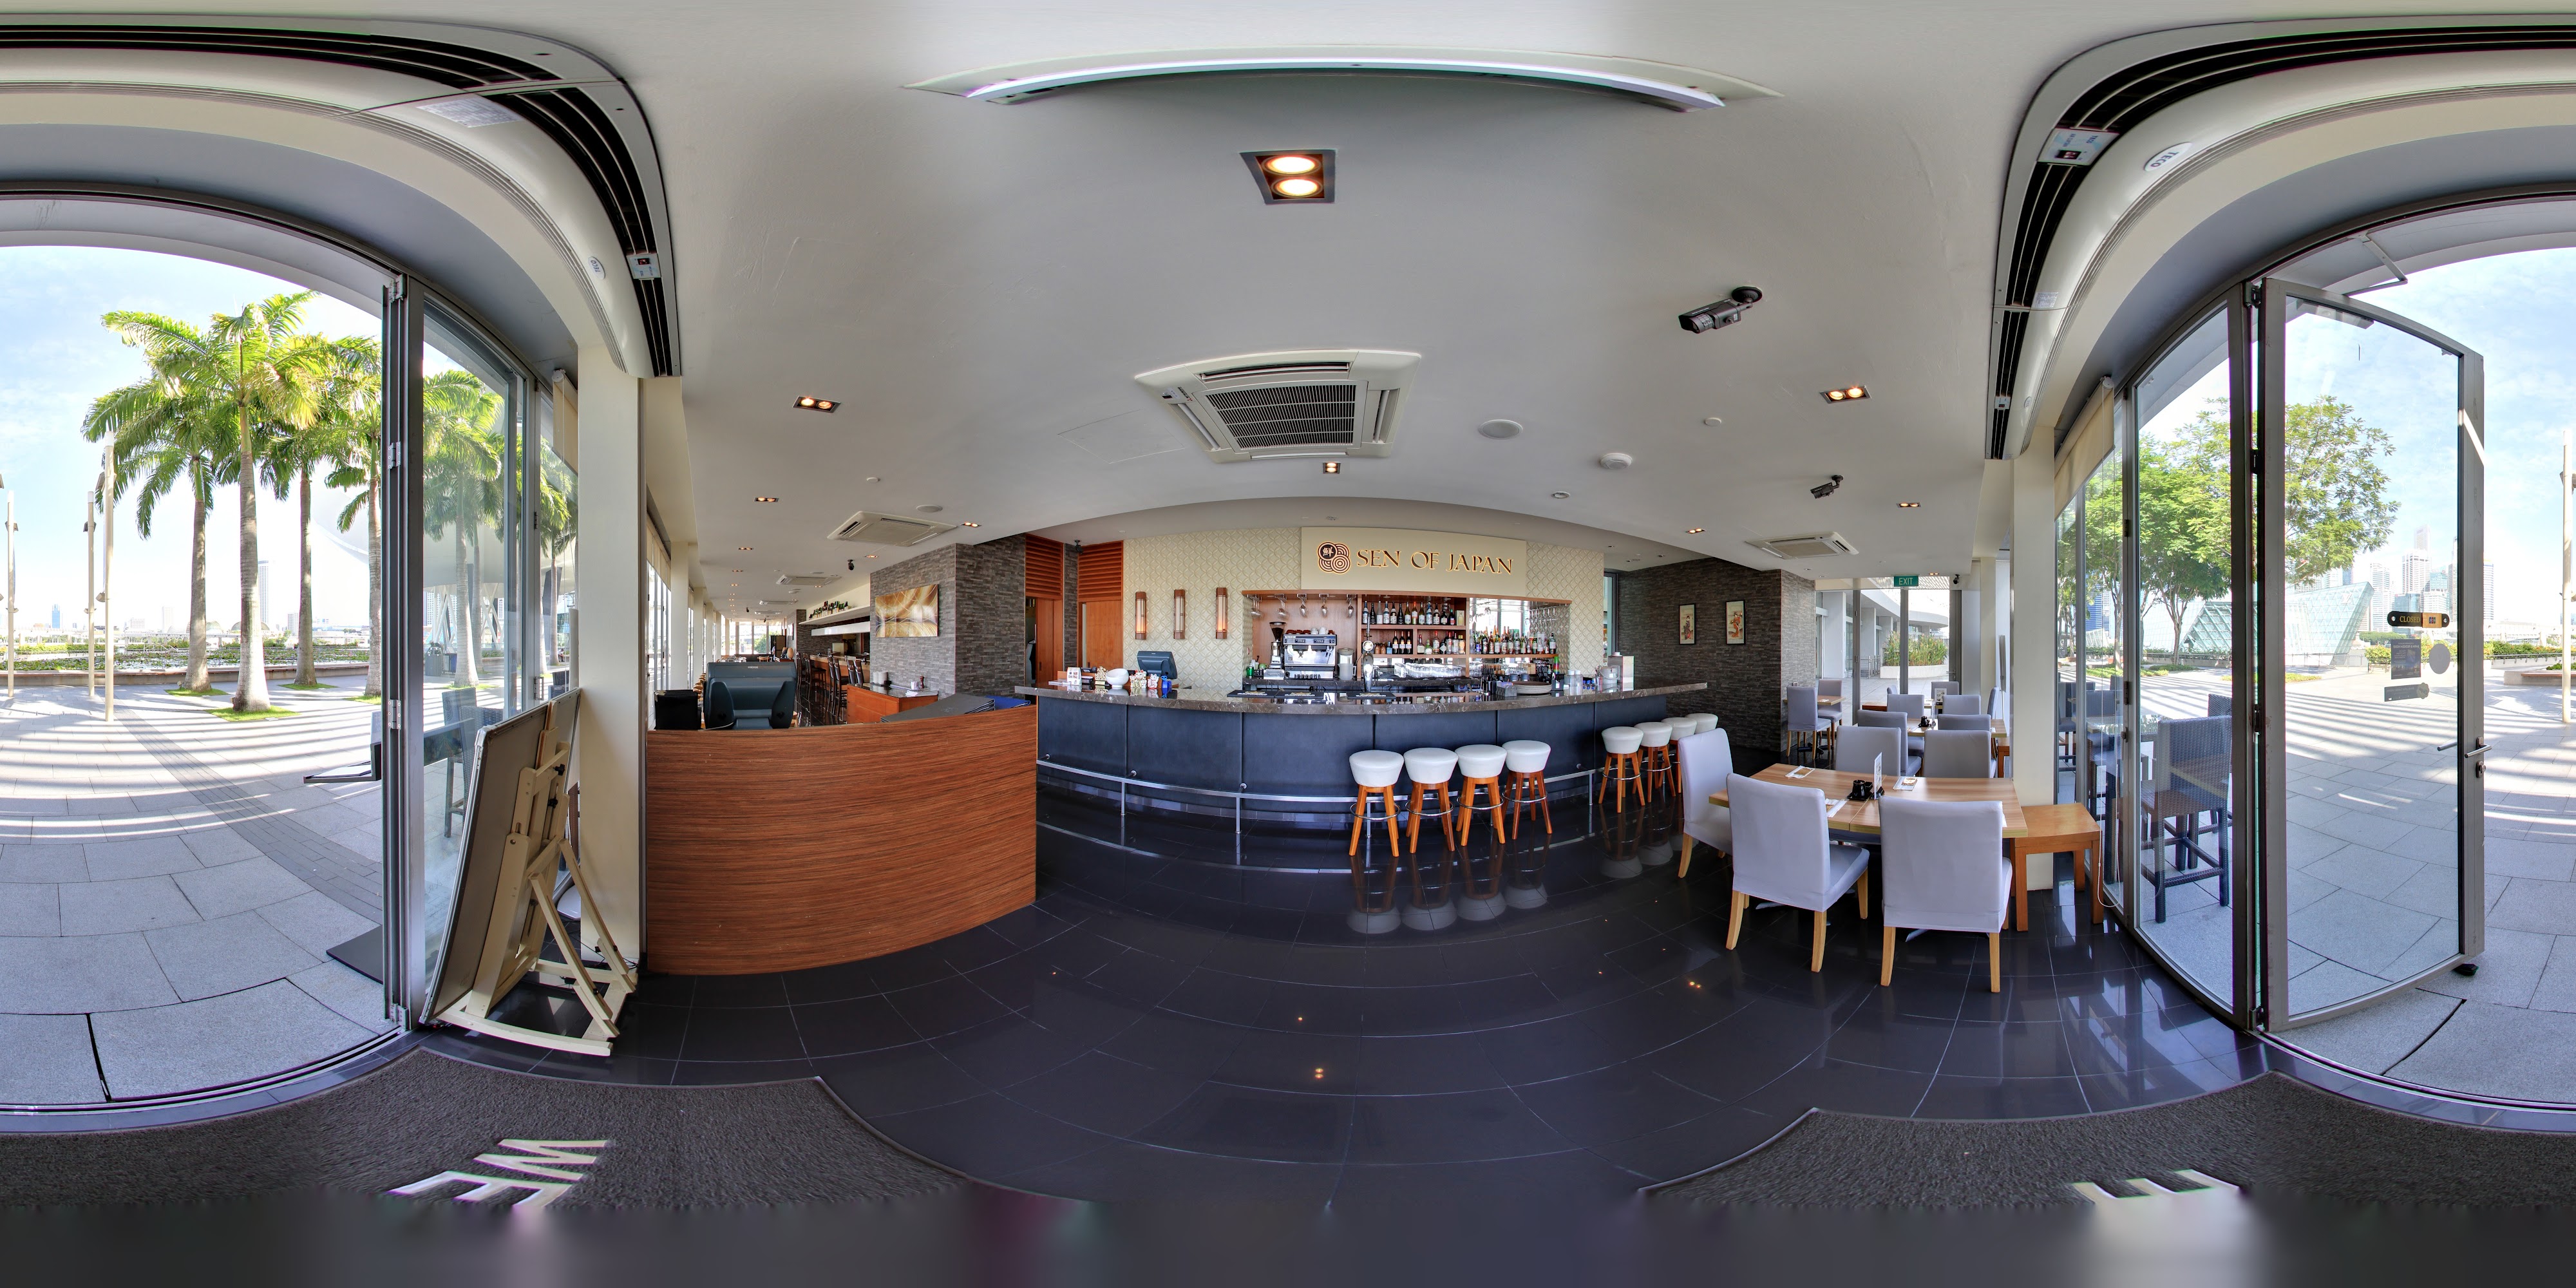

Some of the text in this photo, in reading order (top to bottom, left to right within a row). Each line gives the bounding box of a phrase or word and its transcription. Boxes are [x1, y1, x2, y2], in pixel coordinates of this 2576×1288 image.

[2150, 151, 2179, 168] TECO
[590, 260, 601, 273] TECO
[1322, 546, 1334, 557] 鮮
[1356, 549, 1513, 575] SEN OF JAPAN
[1899, 577, 1913, 585] EXIT
